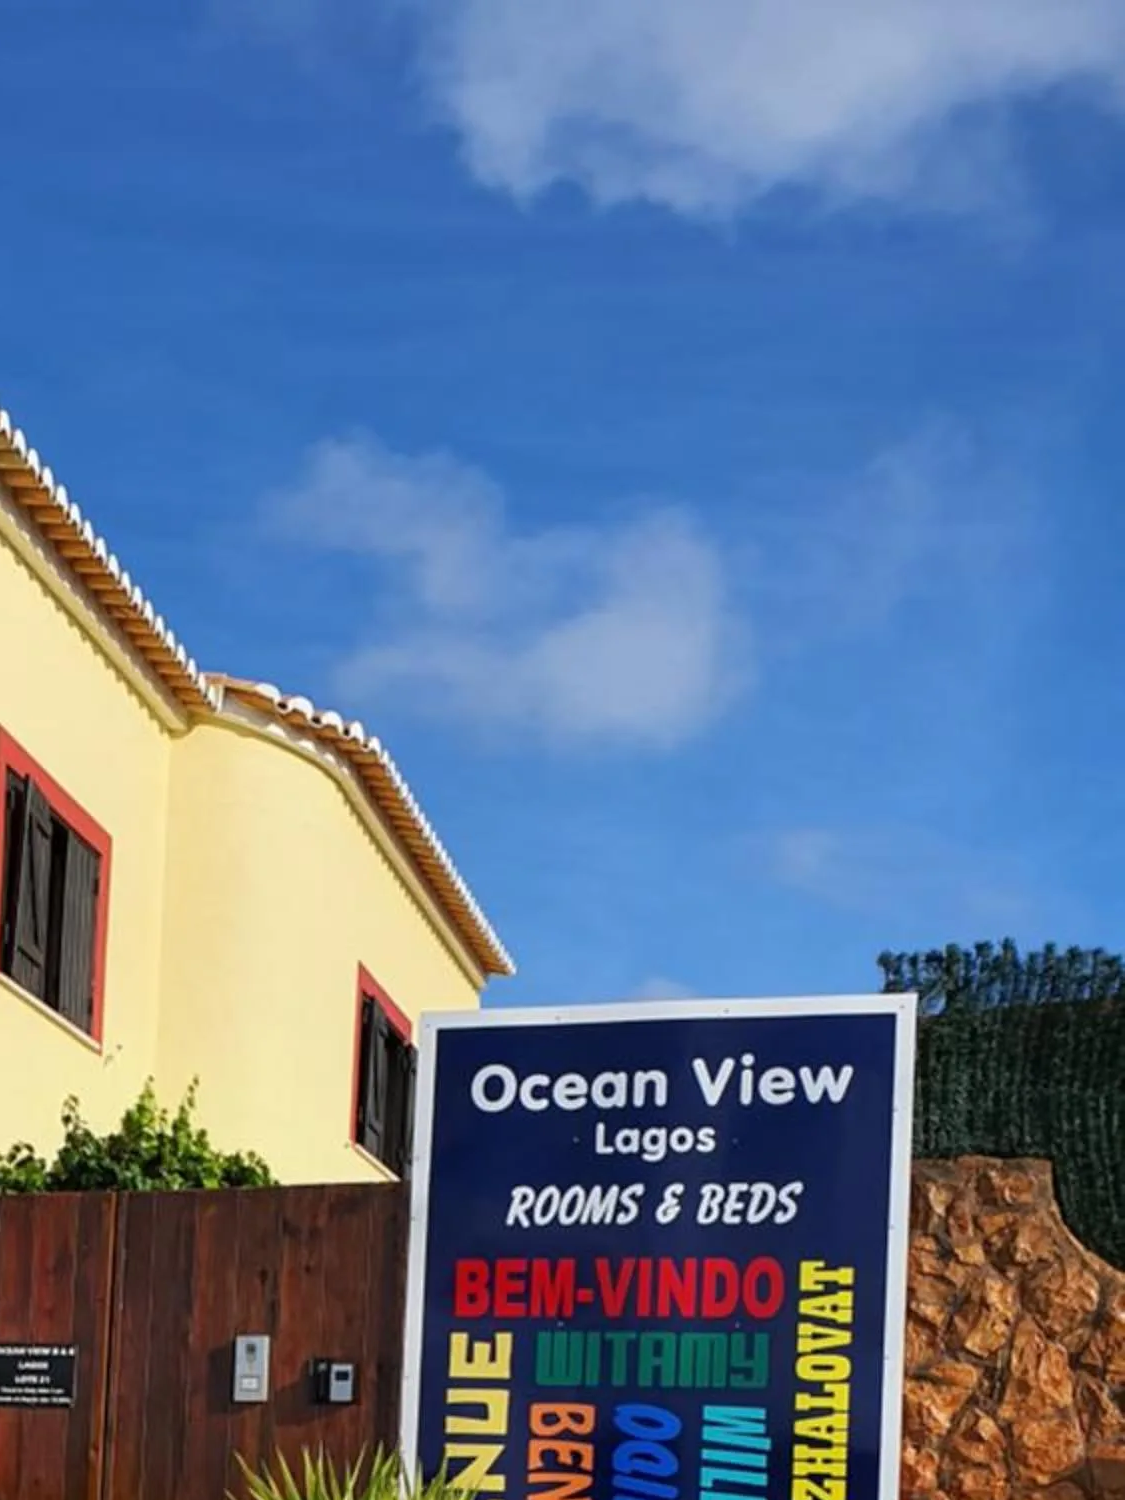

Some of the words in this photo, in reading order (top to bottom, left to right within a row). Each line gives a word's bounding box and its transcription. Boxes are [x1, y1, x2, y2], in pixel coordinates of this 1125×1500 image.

[470, 1063, 668, 1112] Ocean
[692, 1053, 854, 1107] View
[595, 1122, 716, 1162] Lagos
[506, 1184, 643, 1228] ROOMS
[655, 1182, 685, 1226] &
[696, 1181, 804, 1225] BEDS
[453, 1257, 785, 1319] BEM-VINDO
[535, 1330, 771, 1388] WITAMY
